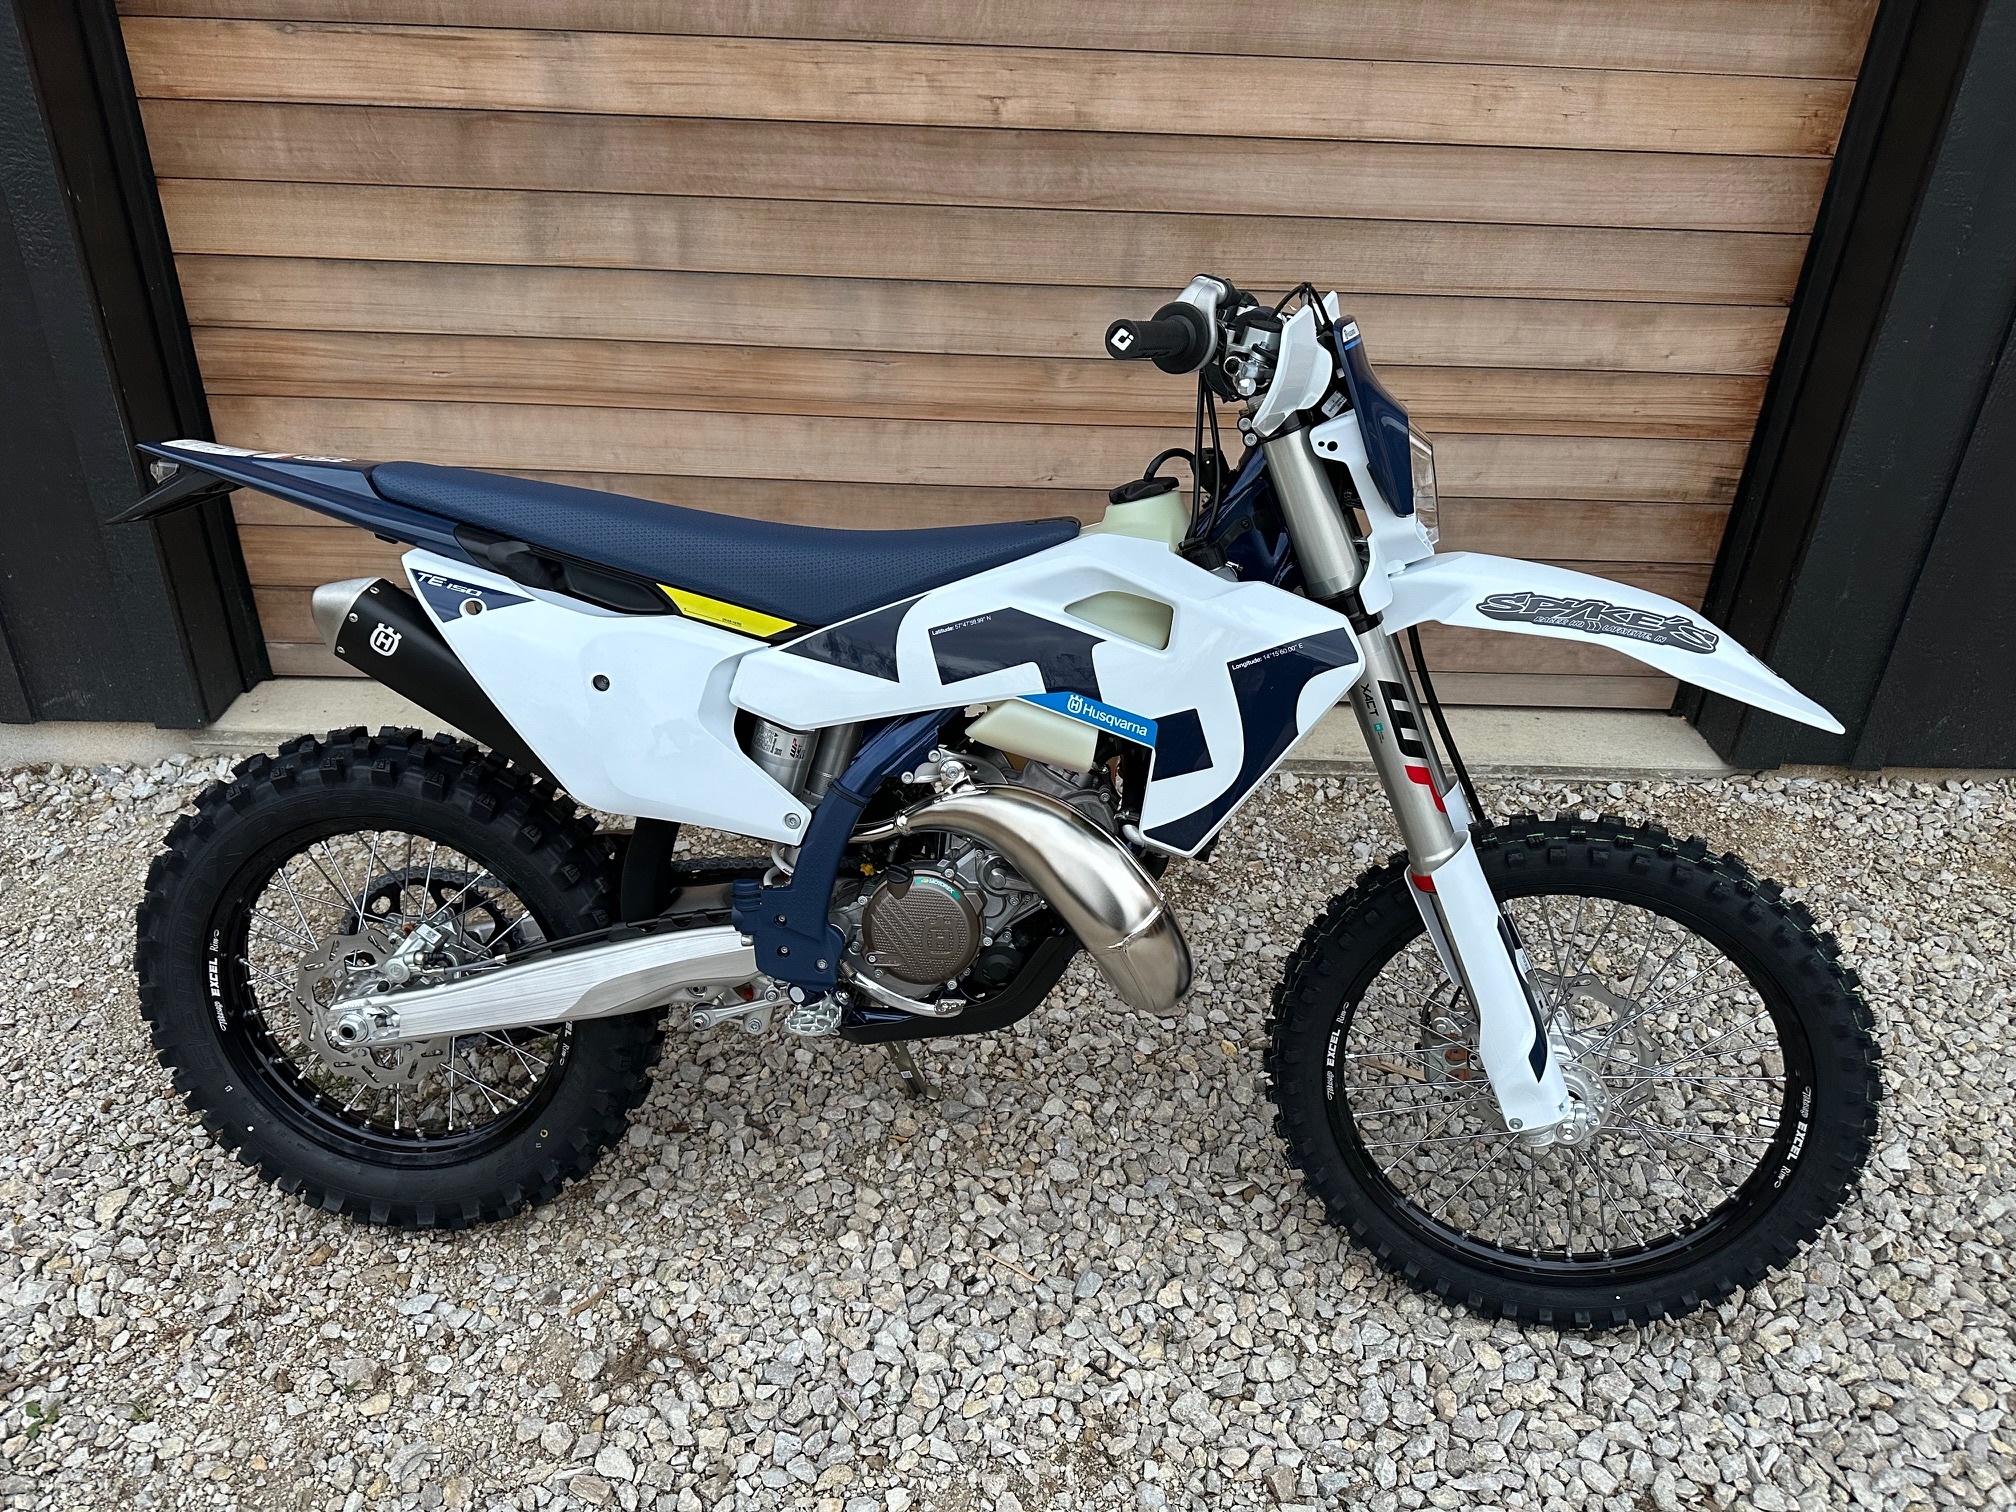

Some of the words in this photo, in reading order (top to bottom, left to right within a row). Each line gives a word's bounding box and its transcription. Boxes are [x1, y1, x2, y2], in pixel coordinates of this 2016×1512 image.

[417, 572, 447, 588] TE
[446, 583, 483, 597] 150
[1477, 593, 1719, 652] SPYKE'S
[1231, 656, 1263, 671] Longitude:
[1298, 642, 1304, 650] E
[1360, 683, 1379, 717] XACT
[1082, 703, 1148, 737] Husqvarna
[208, 929, 220, 952] Rim
[208, 957, 221, 997] EXCEL
[1325, 1029, 1341, 1067] EXCEL
[1786, 1120, 1808, 1161] EXCEL
[1774, 1165, 1792, 1189] Rim
